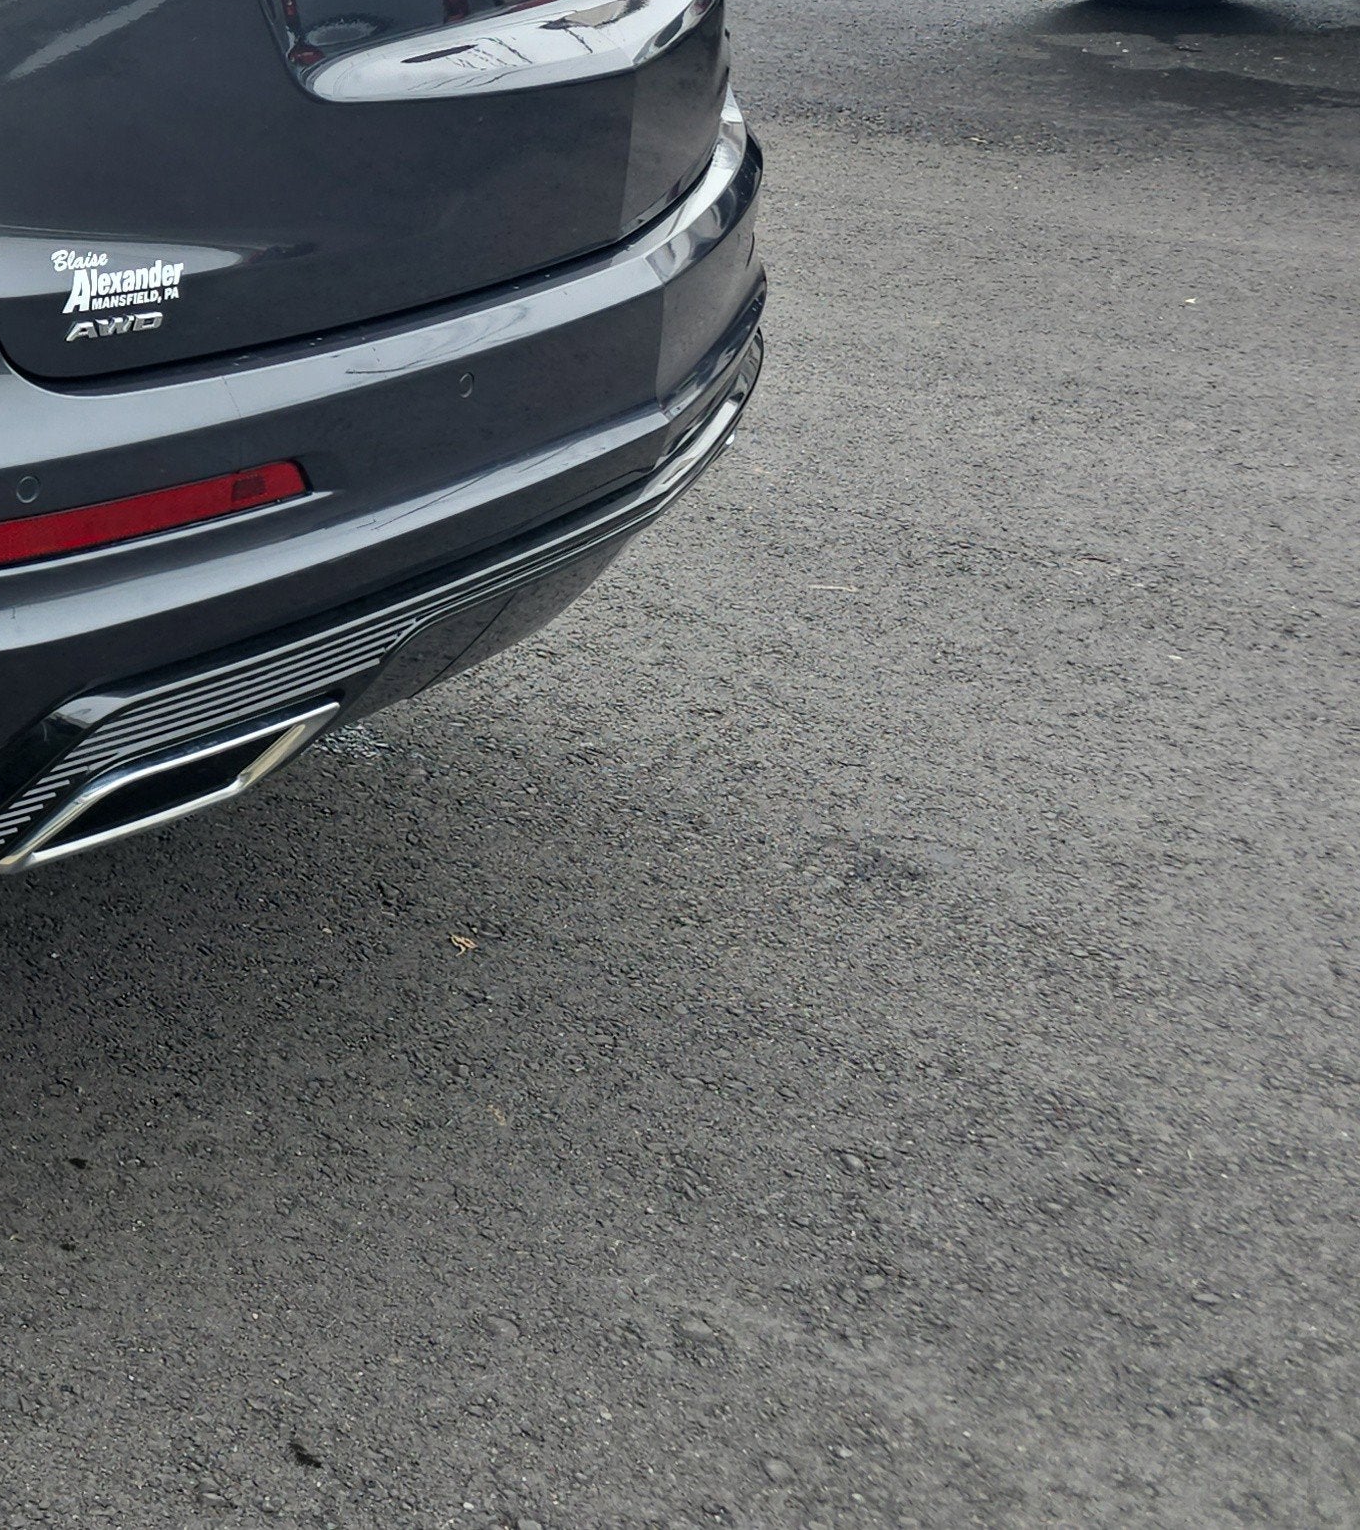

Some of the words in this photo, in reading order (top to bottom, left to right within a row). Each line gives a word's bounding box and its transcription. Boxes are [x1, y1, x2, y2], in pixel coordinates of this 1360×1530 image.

[50, 249, 109, 271] Blaise
[62, 259, 184, 314] Alexander
[91, 288, 162, 311] MANSFIELD,
[164, 287, 180, 300] PA
[65, 311, 164, 342] AWD
